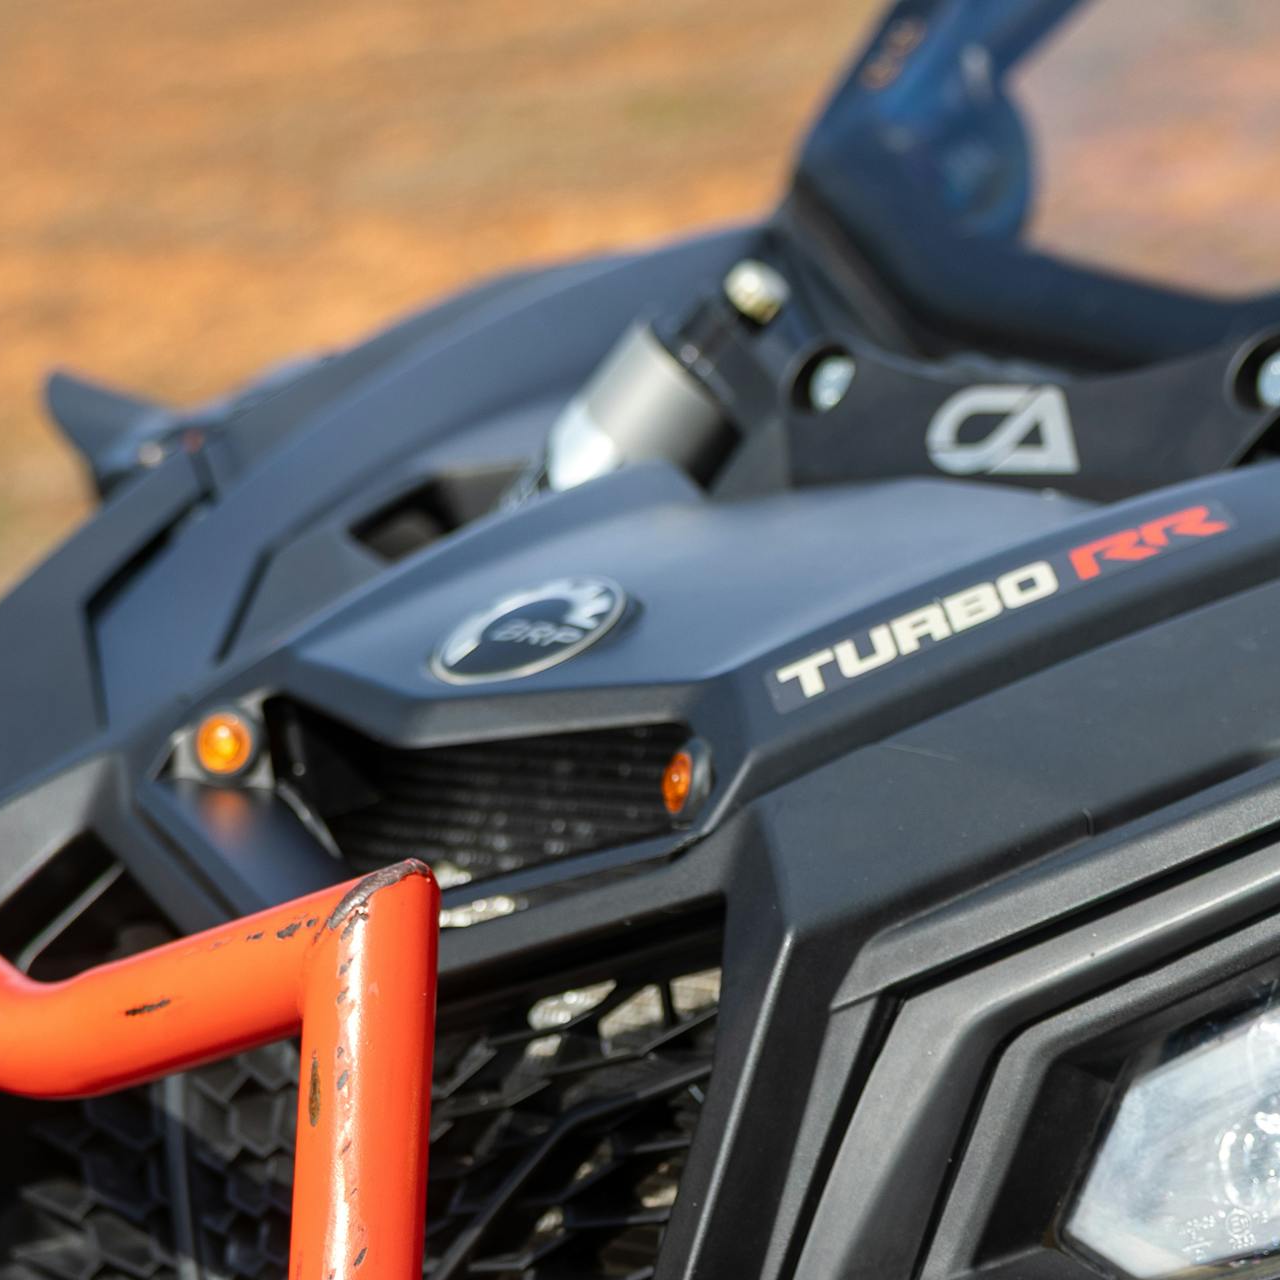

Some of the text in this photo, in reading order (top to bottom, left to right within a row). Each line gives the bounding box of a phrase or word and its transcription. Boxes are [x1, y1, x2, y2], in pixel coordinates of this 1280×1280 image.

[491, 619, 585, 647] BRP
[776, 505, 1229, 698] TURBO RR
